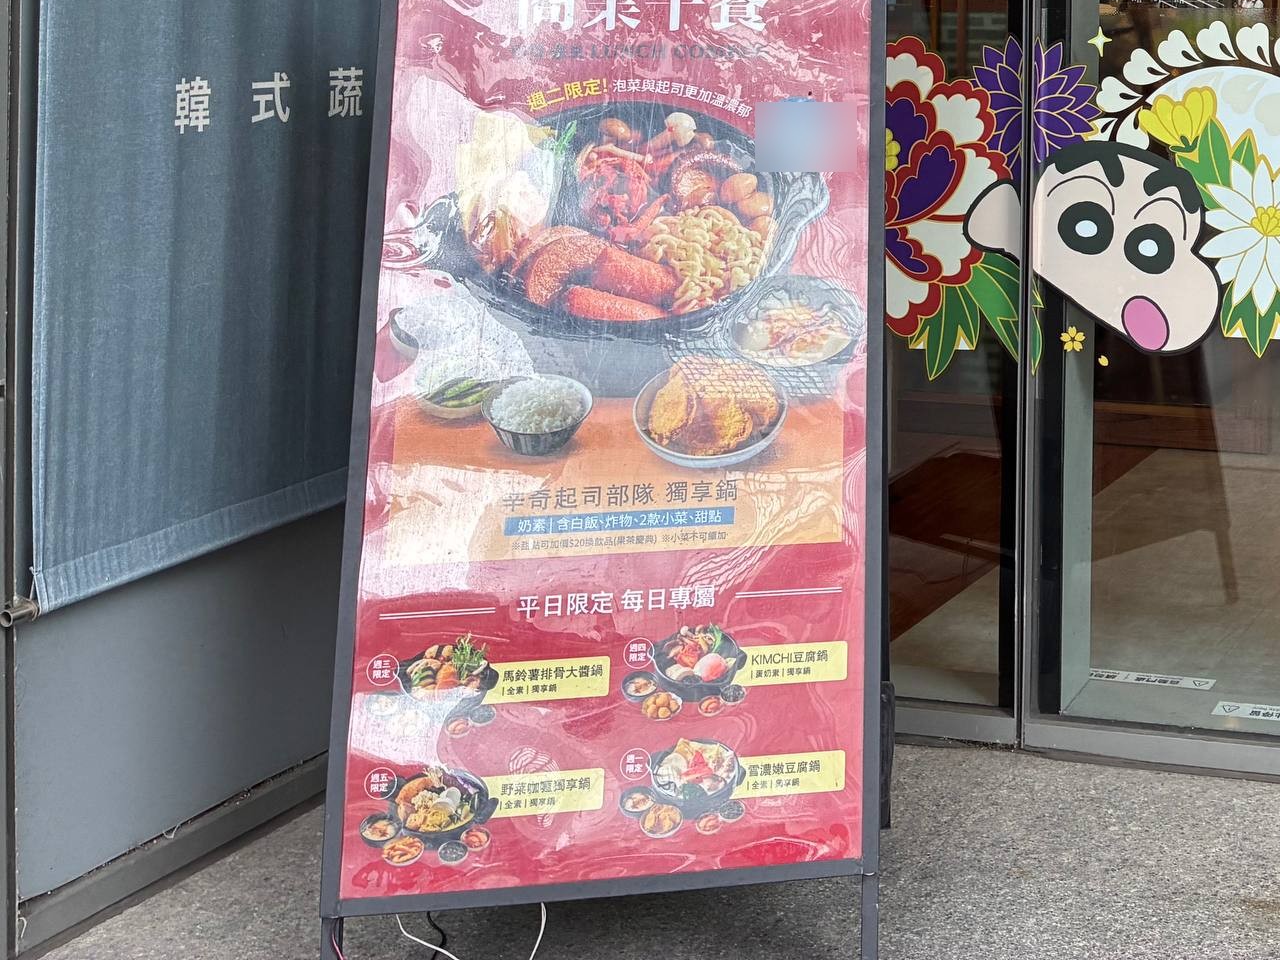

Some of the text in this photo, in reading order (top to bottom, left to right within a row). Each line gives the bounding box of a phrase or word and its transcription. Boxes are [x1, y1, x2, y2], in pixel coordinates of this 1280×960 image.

[526, 79, 608, 113] 週二限定!
[502, 478, 738, 513] 辛奇起司部隊 獨享鍋
[516, 584, 717, 620] 平日限定 每日專屬
[750, 649, 829, 666] KIMCHI豆腐鍋
